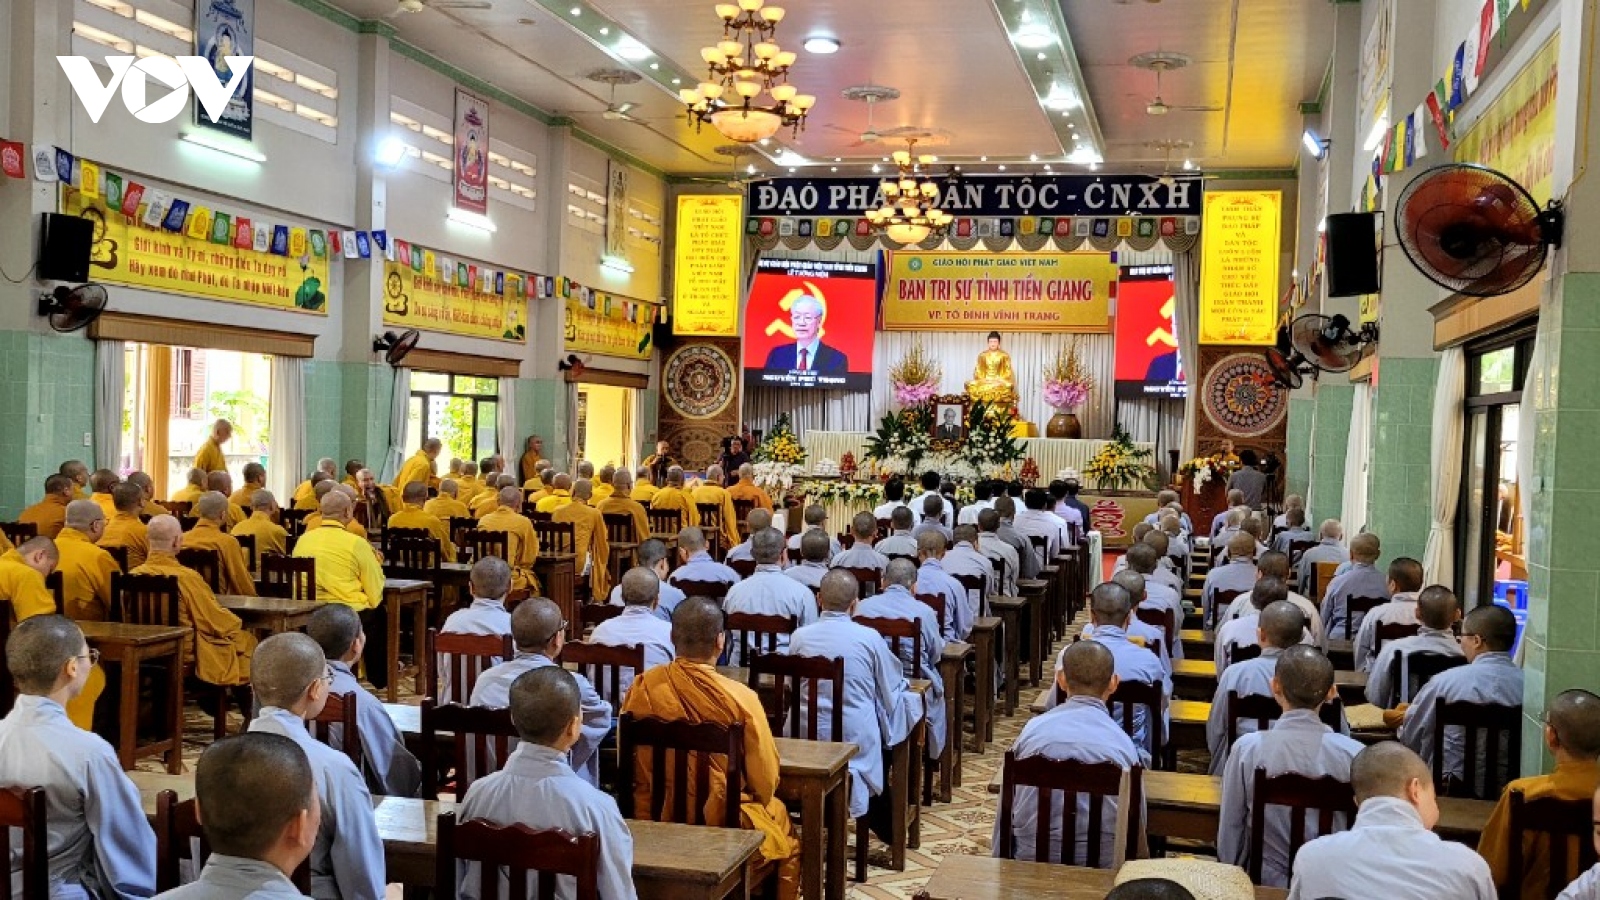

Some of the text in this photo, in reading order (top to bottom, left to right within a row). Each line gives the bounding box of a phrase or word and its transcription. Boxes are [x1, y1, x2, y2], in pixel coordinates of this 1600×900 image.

[1084, 182, 1191, 210] CNXH
[1038, 259, 1058, 268] NAM
[899, 279, 926, 301] BAN
[930, 279, 951, 305] TRỊ
[955, 277, 975, 305] SỰ
[977, 271, 1008, 301] TỈNH
[1046, 280, 1092, 301] GIANG
